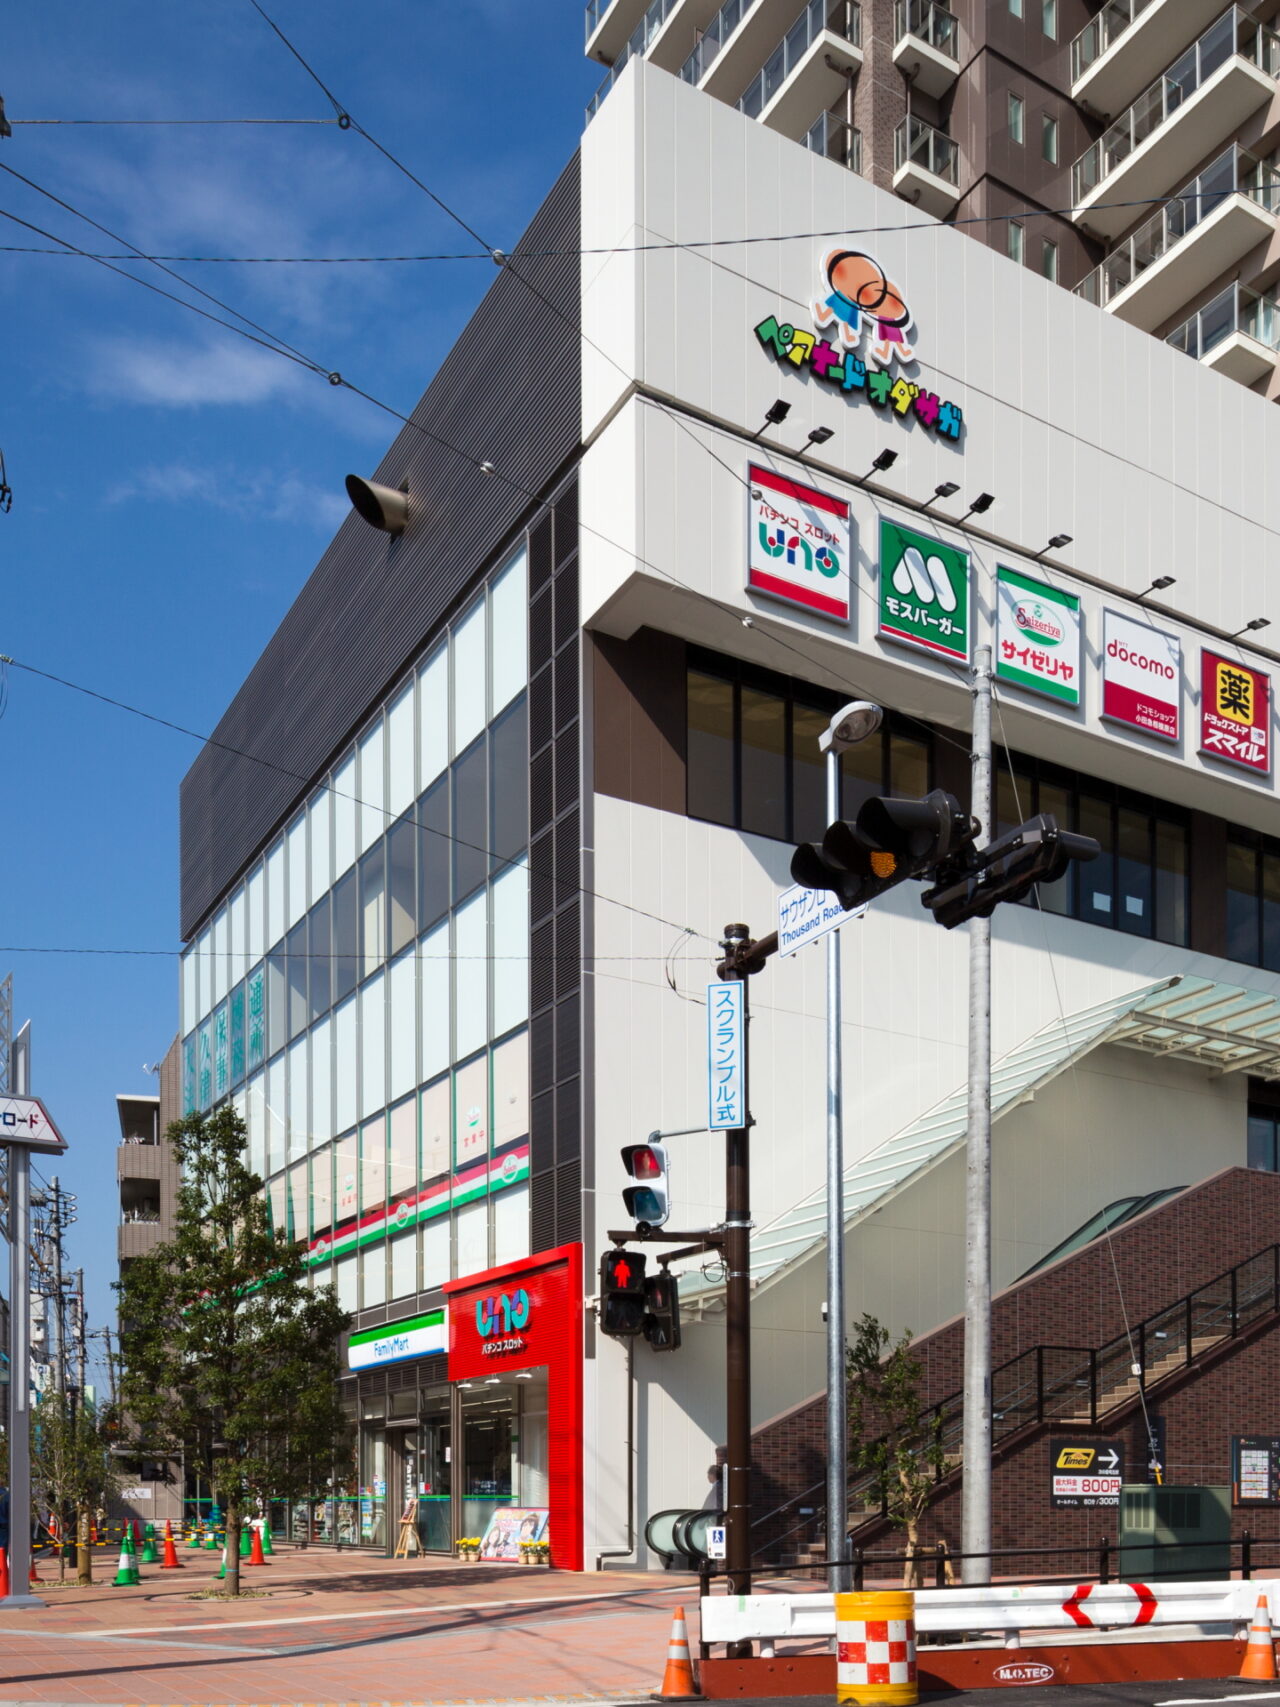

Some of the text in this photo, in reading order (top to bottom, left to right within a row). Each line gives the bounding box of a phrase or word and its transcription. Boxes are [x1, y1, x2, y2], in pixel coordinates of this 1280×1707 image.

[759, 505, 840, 545] パチンコ スロット
[759, 521, 840, 578] uno
[886, 596, 964, 635] モスバーガー
[1016, 607, 1060, 638] Saizeriya
[1001, 639, 1073, 681] サイゼリヤ
[1107, 639, 1174, 679] docomo
[1219, 668, 1250, 720] 薬
[1136, 703, 1175, 723] ドコモショップ
[1204, 712, 1249, 735] ドラッグストア
[1204, 728, 1265, 762] スマイル
[781, 888, 826, 928] サウザンロ
[782, 912, 820, 945] Thousand
[716, 990, 736, 1122] スクランブル式
[0, 1112, 39, 1129] ロード
[476, 1289, 529, 1336] uno
[374, 1336, 409, 1358] FamilyMart
[503, 1336, 523, 1350] スロット
[1063, 1453, 1088, 1465] Times
[1082, 1479, 1120, 1492] 800円
[999, 1667, 1049, 1680] M.O.TEC
